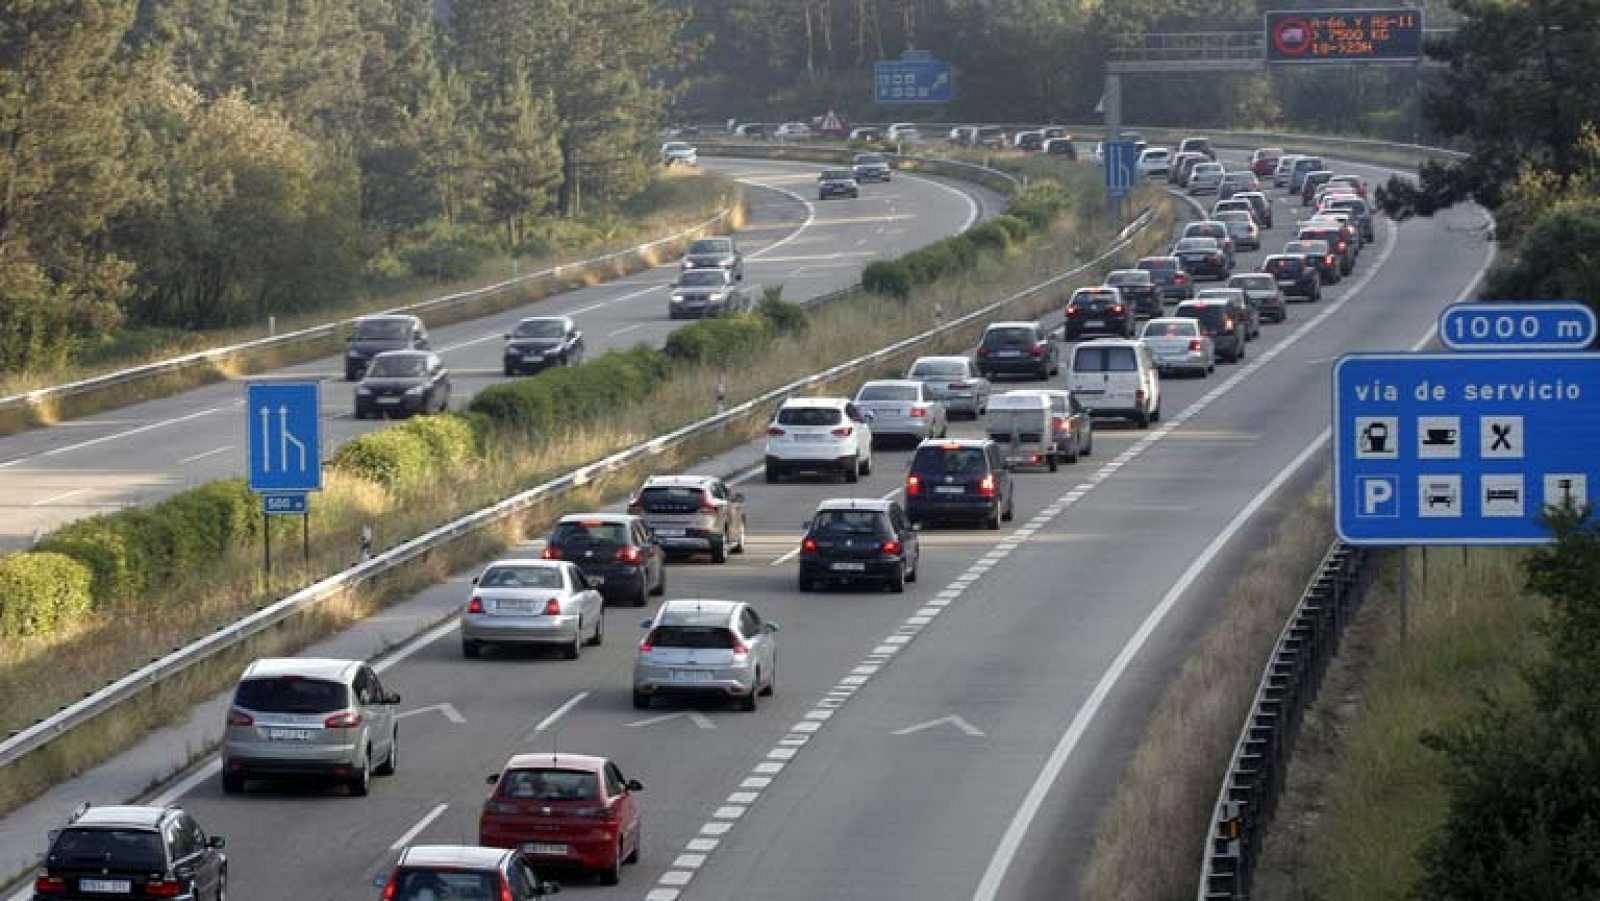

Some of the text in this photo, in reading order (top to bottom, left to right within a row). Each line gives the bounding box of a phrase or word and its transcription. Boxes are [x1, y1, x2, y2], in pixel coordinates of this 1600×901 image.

[1455, 316, 1582, 338] 1000 m
[1414, 380, 1447, 401] de
[1464, 379, 1580, 401] servicio
[1364, 478, 1392, 514] P
